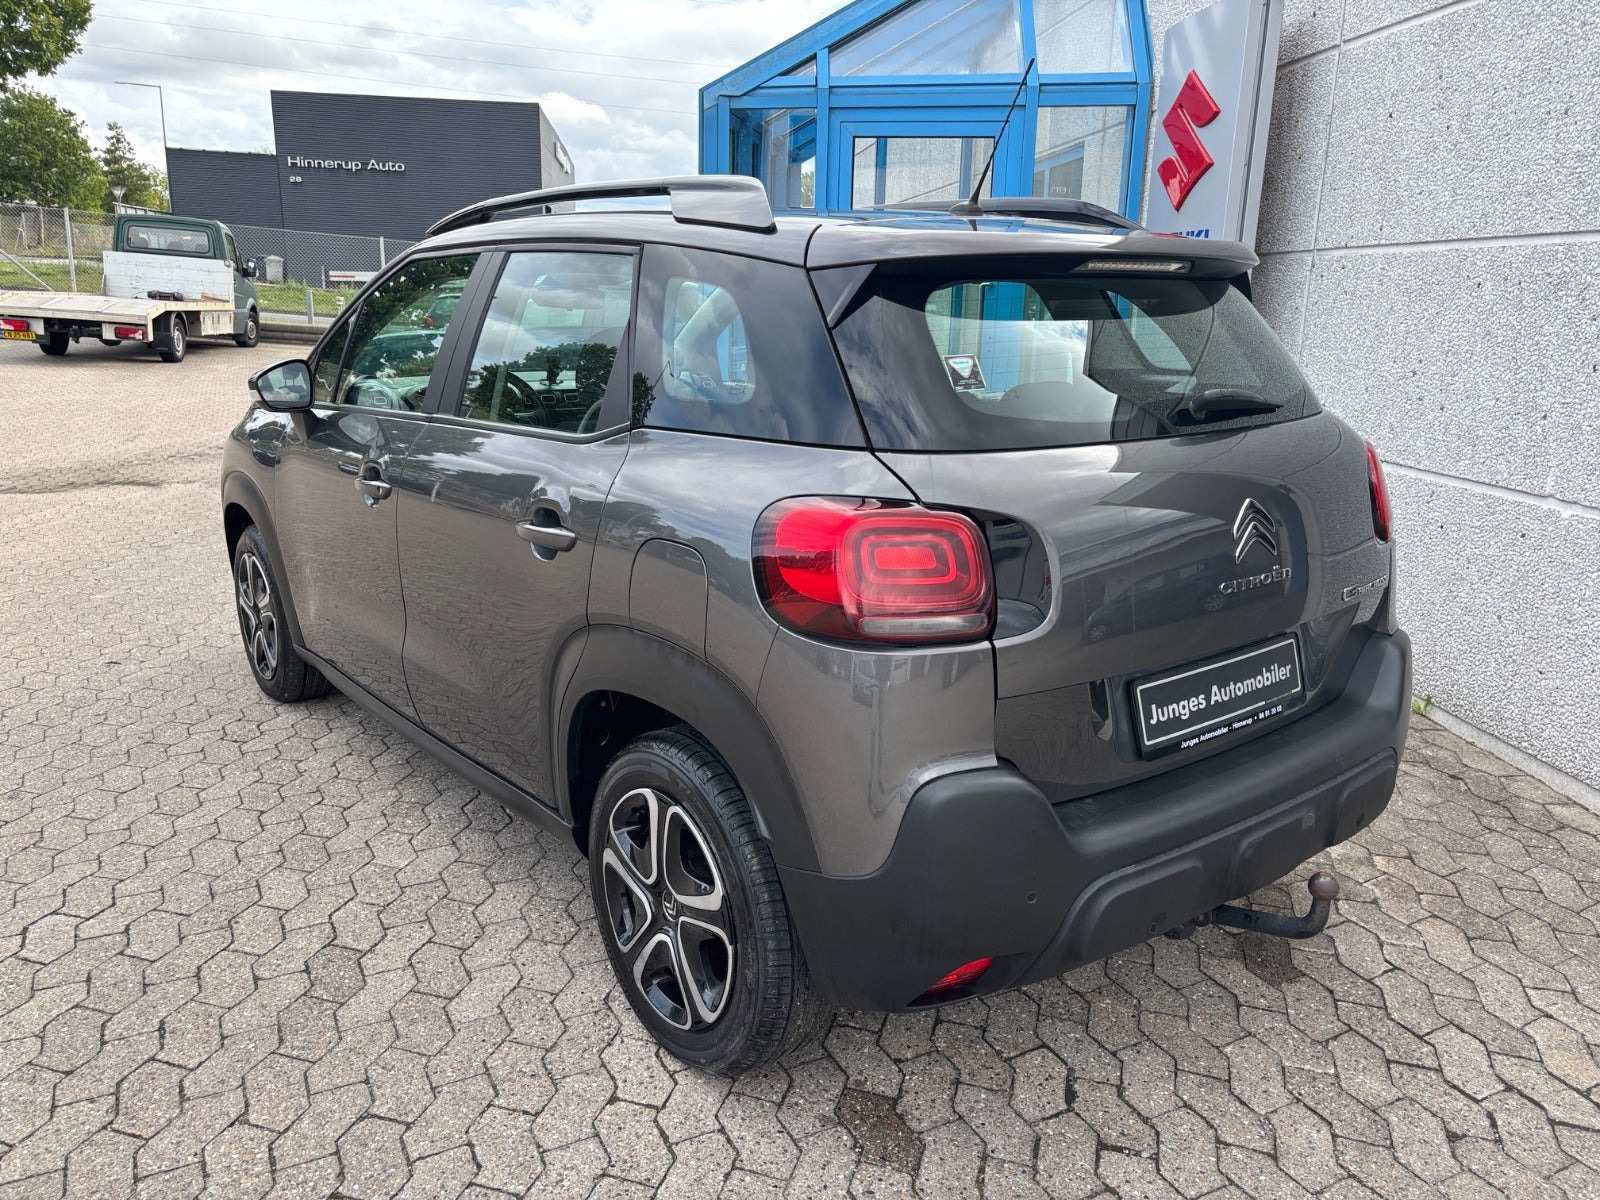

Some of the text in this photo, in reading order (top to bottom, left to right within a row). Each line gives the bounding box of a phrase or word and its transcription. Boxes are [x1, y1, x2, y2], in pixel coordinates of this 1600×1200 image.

[287, 156, 405, 172] Hinnerup Auto
[1149, 663, 1292, 725] Junges Automobiler
[1180, 737, 1199, 748] Junges
[1199, 725, 1229, 742] Automobiler
[1232, 717, 1253, 730] Hinnerup
